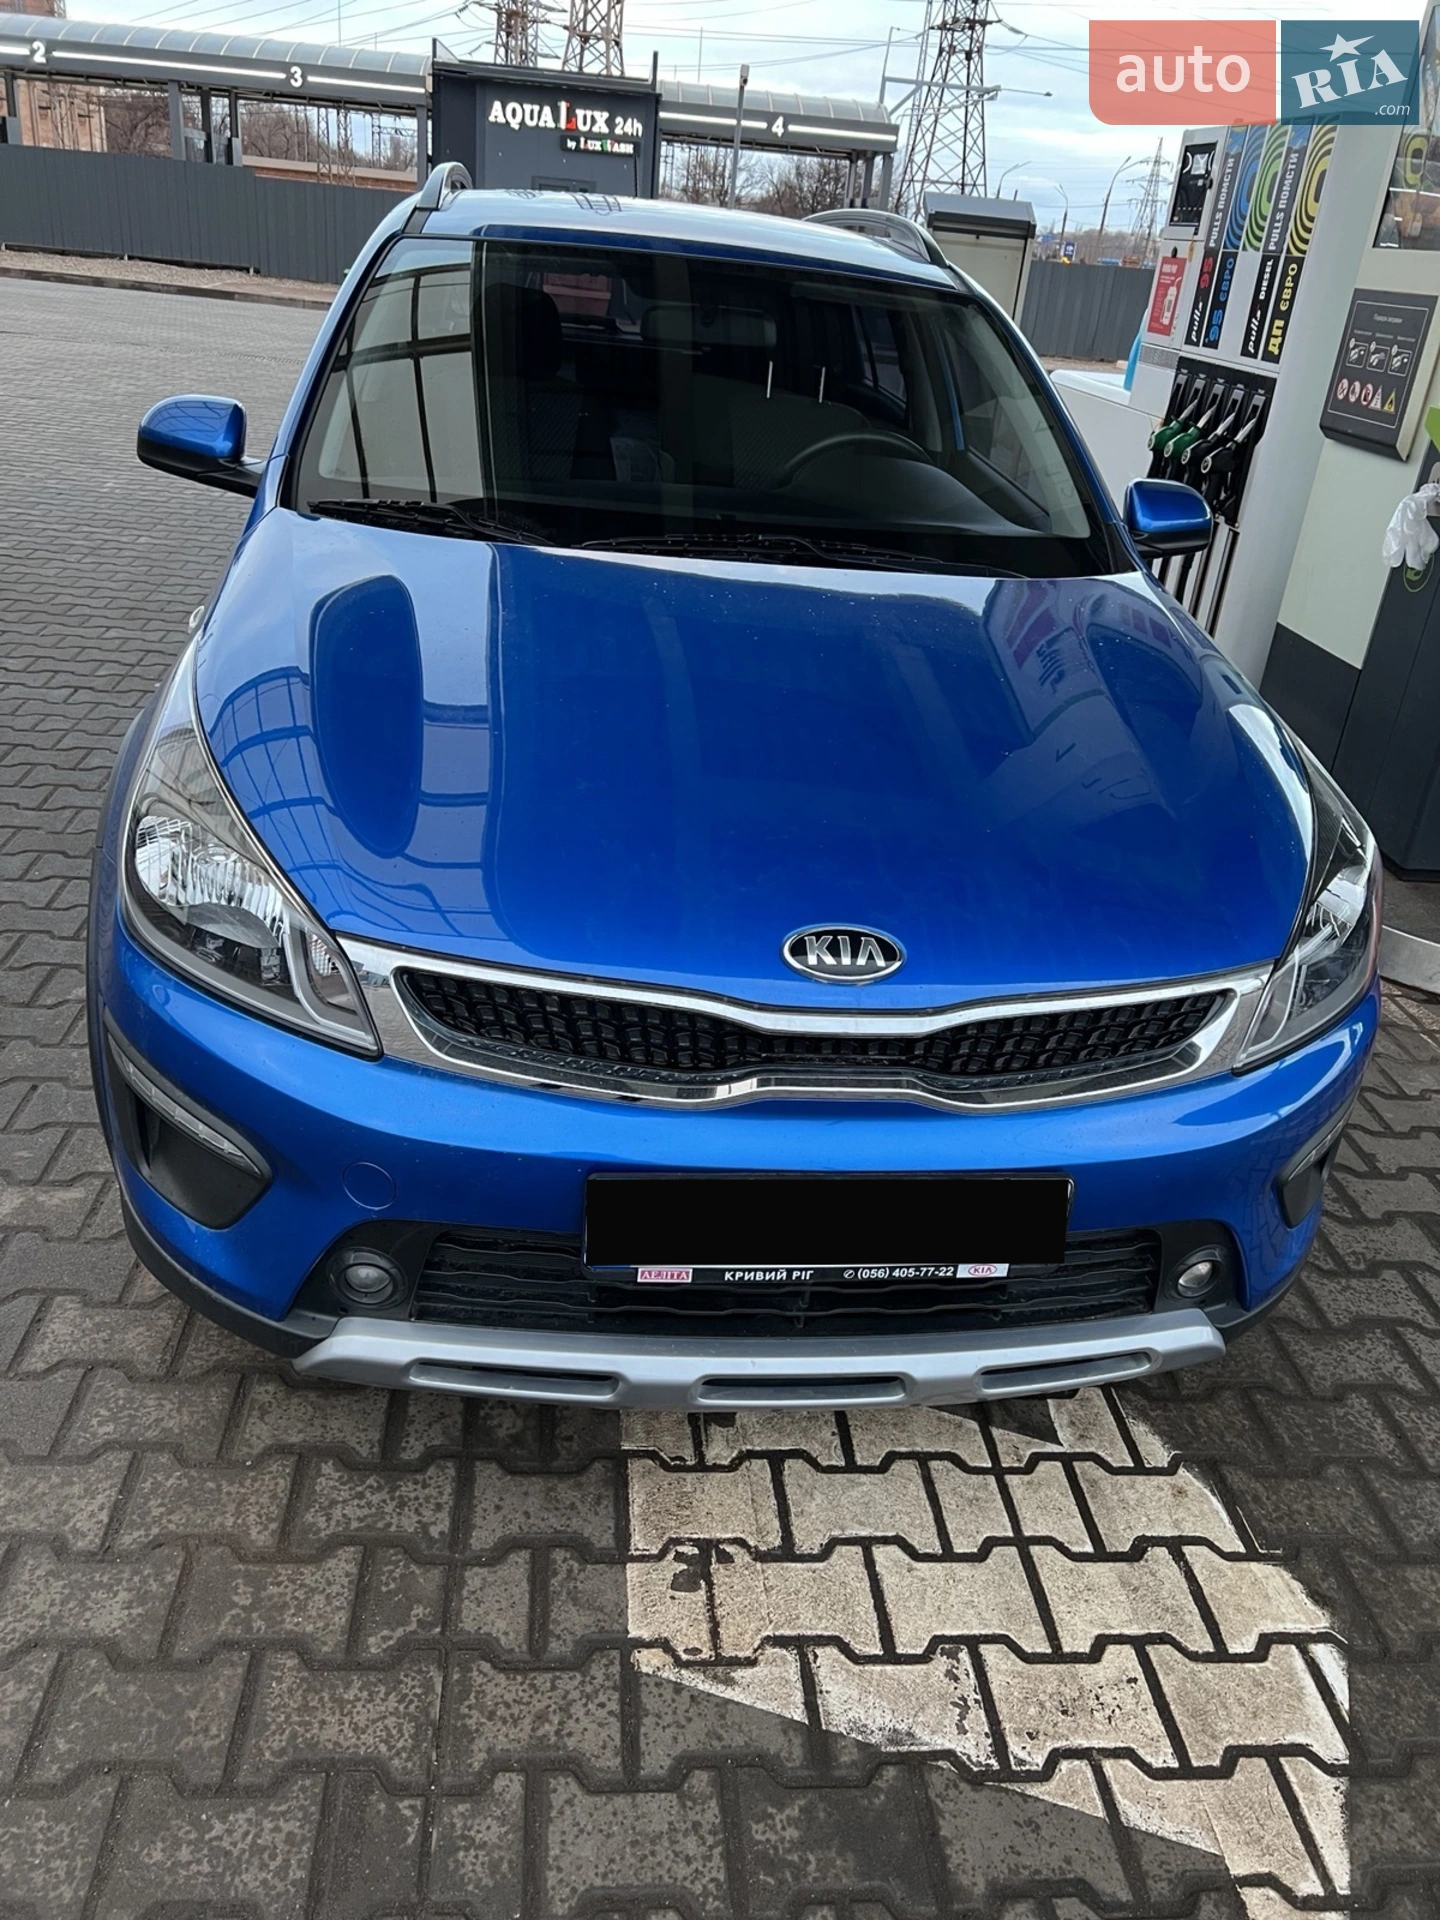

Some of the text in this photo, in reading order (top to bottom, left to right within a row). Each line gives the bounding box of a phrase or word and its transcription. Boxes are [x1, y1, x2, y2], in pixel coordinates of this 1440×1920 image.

[29, 40, 48, 64] 2
[289, 65, 304, 88] 3
[614, 115, 643, 137] 24h
[771, 115, 785, 138] 4
[566, 138, 577, 150] by
[1209, 157, 1235, 247] PULLS ПОМСТИ
[1268, 153, 1299, 250] PULLS ПОМСТИ
[1199, 257, 1213, 289] 95
[1259, 258, 1274, 300] DIESEL
[1209, 257, 1235, 341] 95 ЄВРО
[1267, 263, 1298, 355] ДП ЄВРО
[804, 935, 887, 967] KIA
[724, 1268, 814, 1281] КРИВИЙ РІГ
[857, 1266, 955, 1280] (056) 405-77-22
